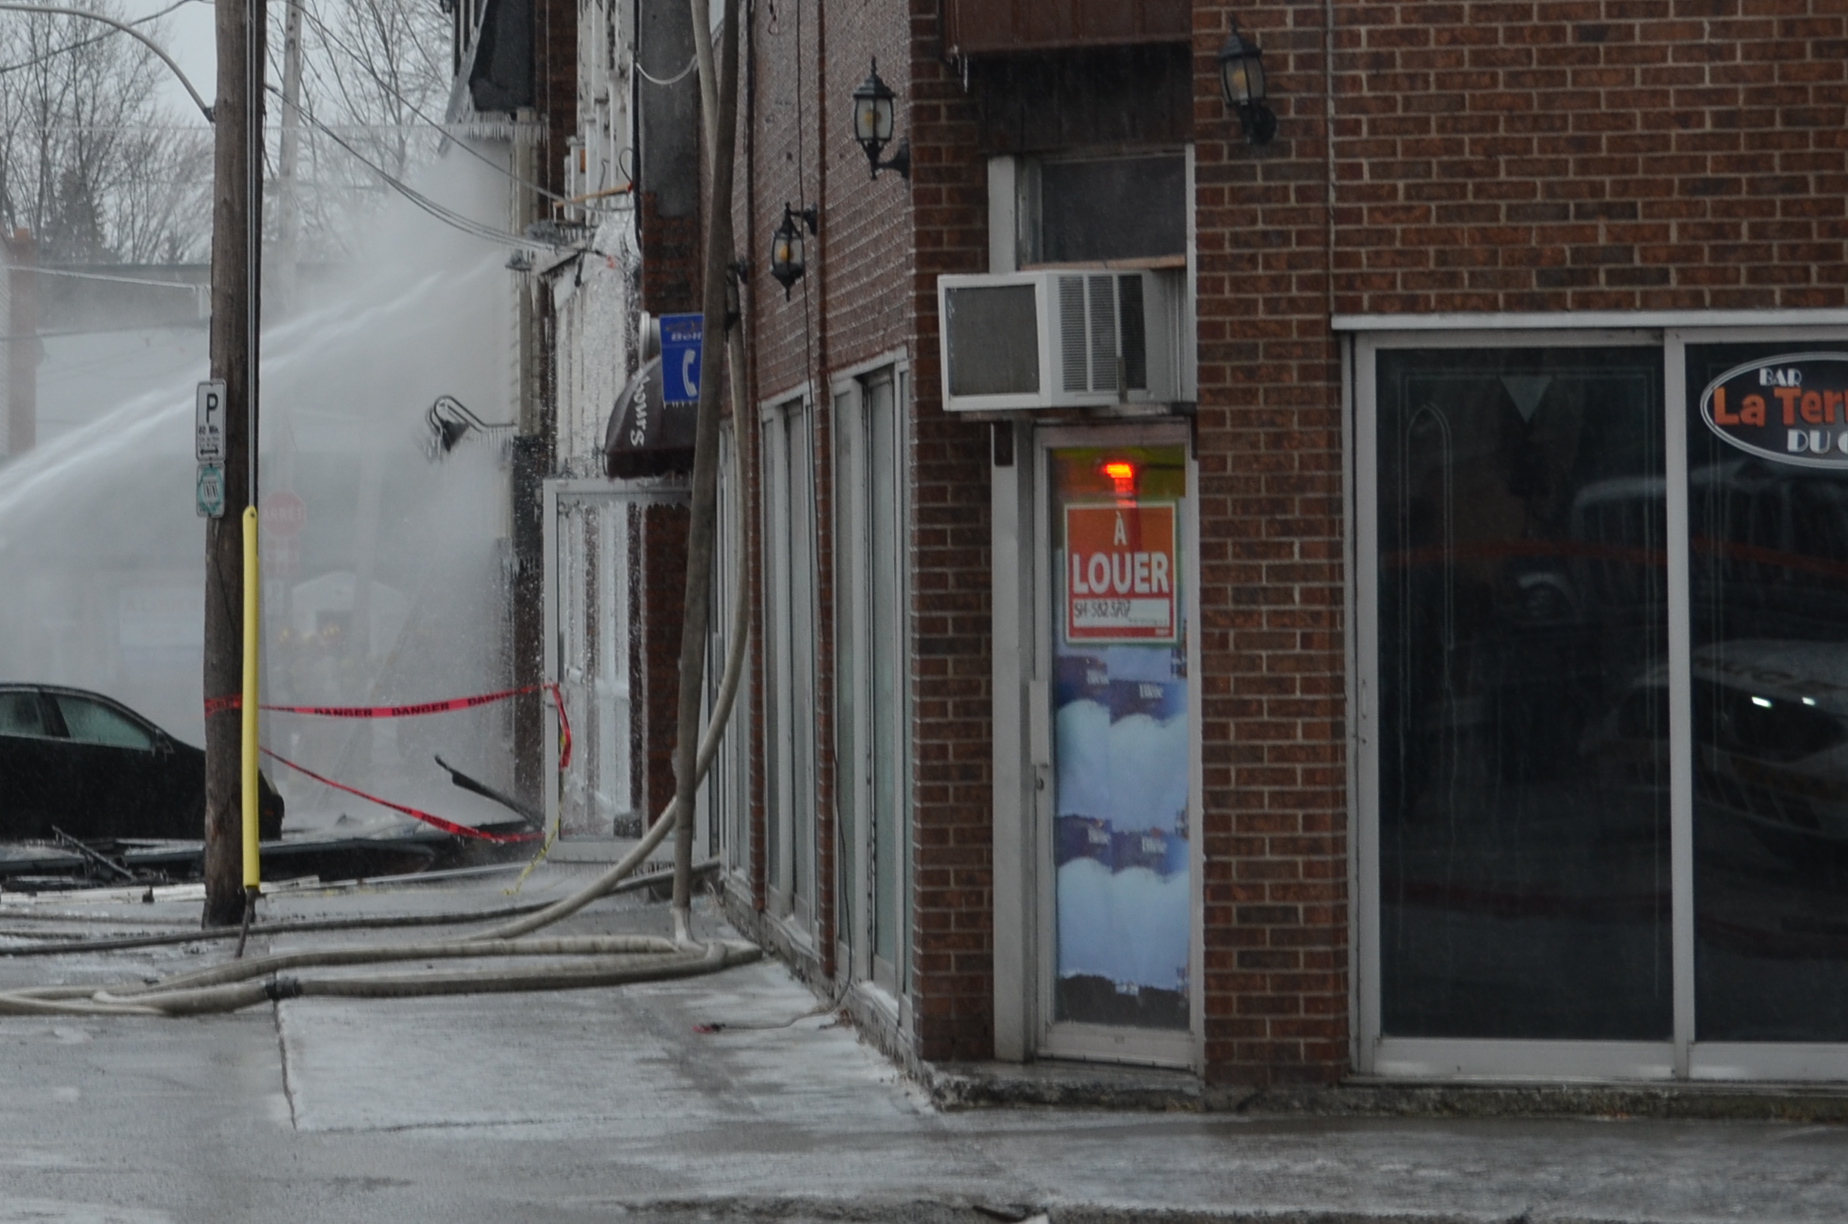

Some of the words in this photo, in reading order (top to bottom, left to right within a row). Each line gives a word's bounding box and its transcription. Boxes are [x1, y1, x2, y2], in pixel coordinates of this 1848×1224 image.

[1759, 367, 1802, 387] BAR
[206, 393, 218, 423] P
[1713, 387, 1766, 427] La
[1773, 387, 1848, 426] Ter
[1787, 429, 1831, 454] DU
[1114, 511, 1127, 546] À
[1072, 551, 1169, 594] LOUER
[314, 707, 373, 718] DANGER
[392, 702, 450, 716] DANGER
